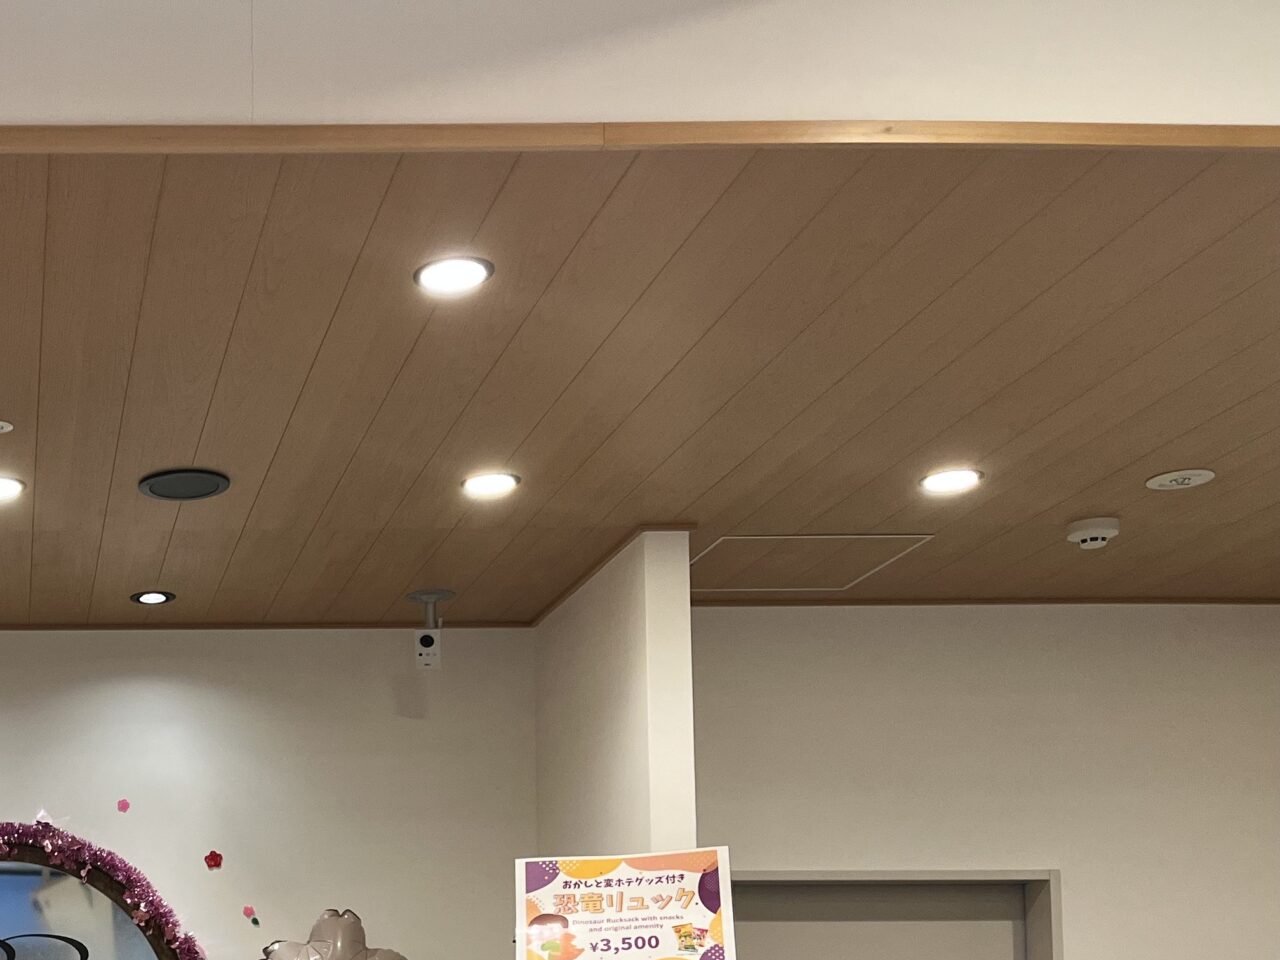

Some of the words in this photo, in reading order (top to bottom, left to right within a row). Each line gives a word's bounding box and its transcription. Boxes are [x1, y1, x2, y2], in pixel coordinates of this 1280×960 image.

[552, 887, 696, 915] 恐竜リュック
[606, 916, 639, 924] Rucksack
[640, 914, 658, 922] with
[659, 913, 684, 921] snacks
[603, 924, 632, 933] original
[633, 922, 663, 932] amenity
[590, 935, 660, 954] ¥3,500
